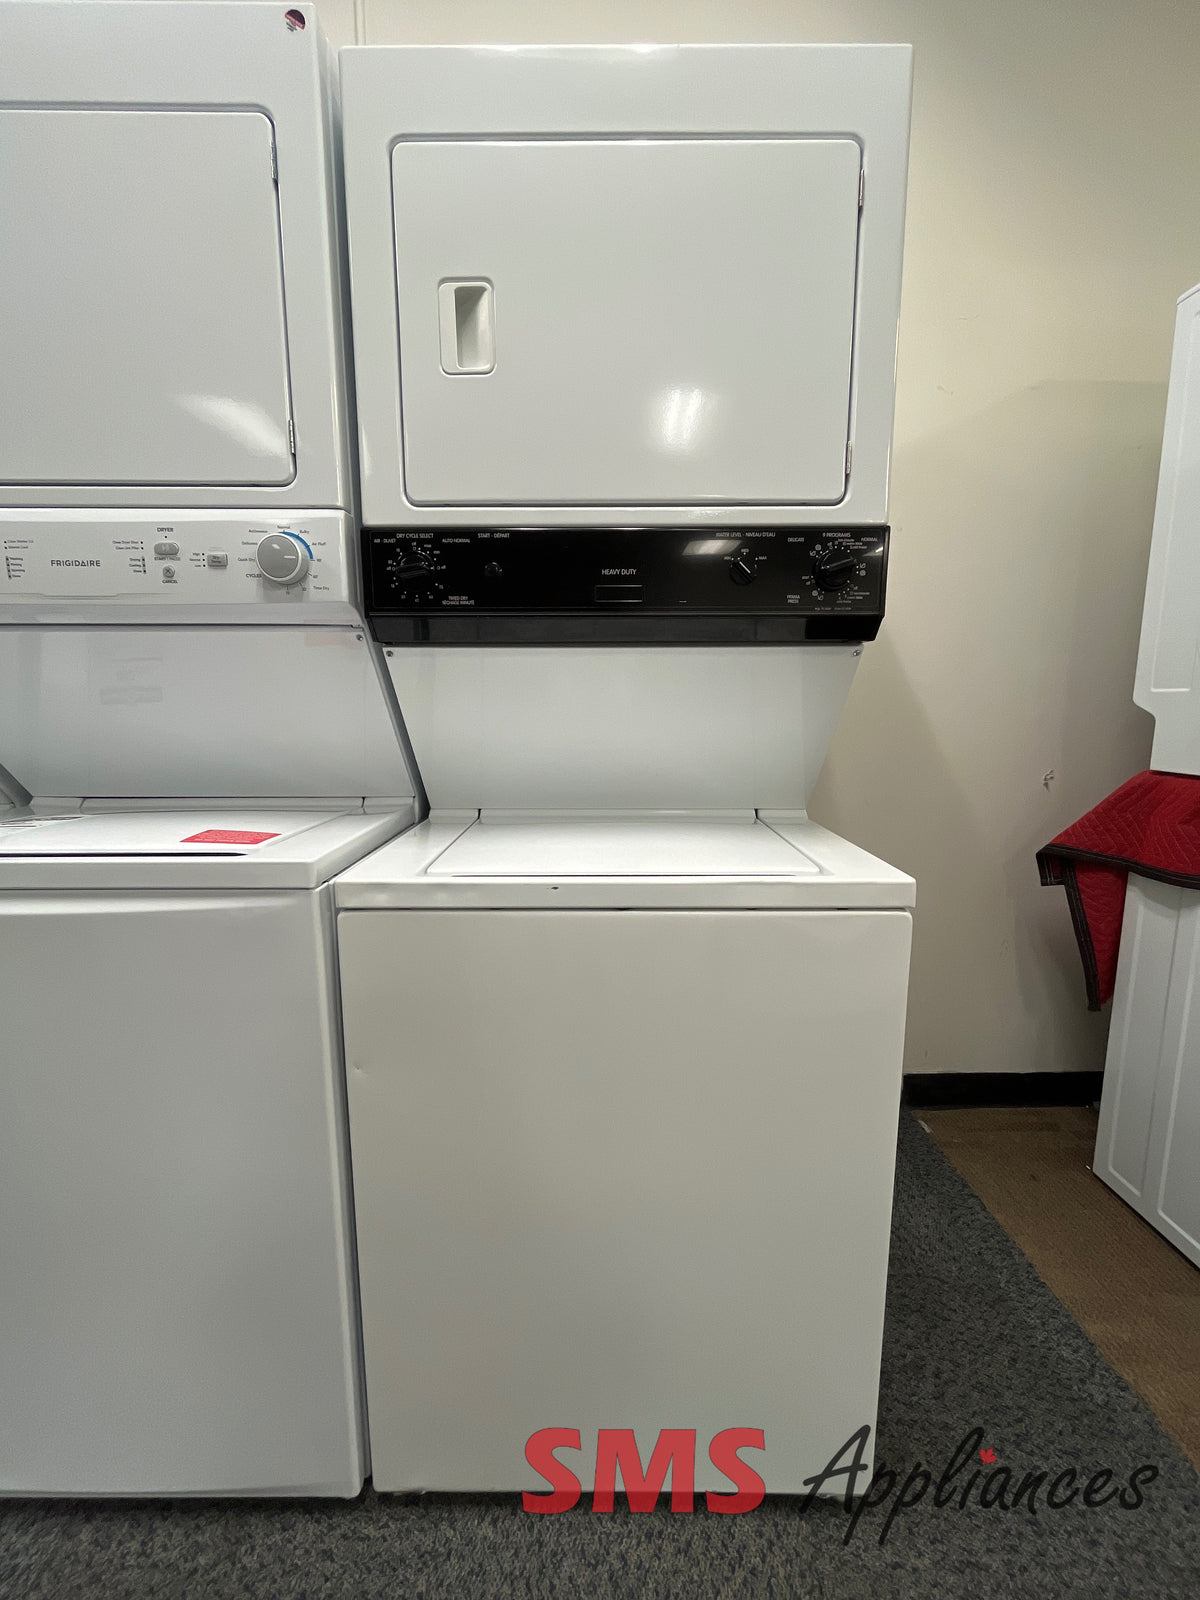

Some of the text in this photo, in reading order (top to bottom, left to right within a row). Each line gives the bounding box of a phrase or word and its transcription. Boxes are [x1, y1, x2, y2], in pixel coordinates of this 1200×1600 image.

[50, 559, 102, 568] FRIGIDAIRE
[601, 568, 637, 576] HEAVY DUTY
